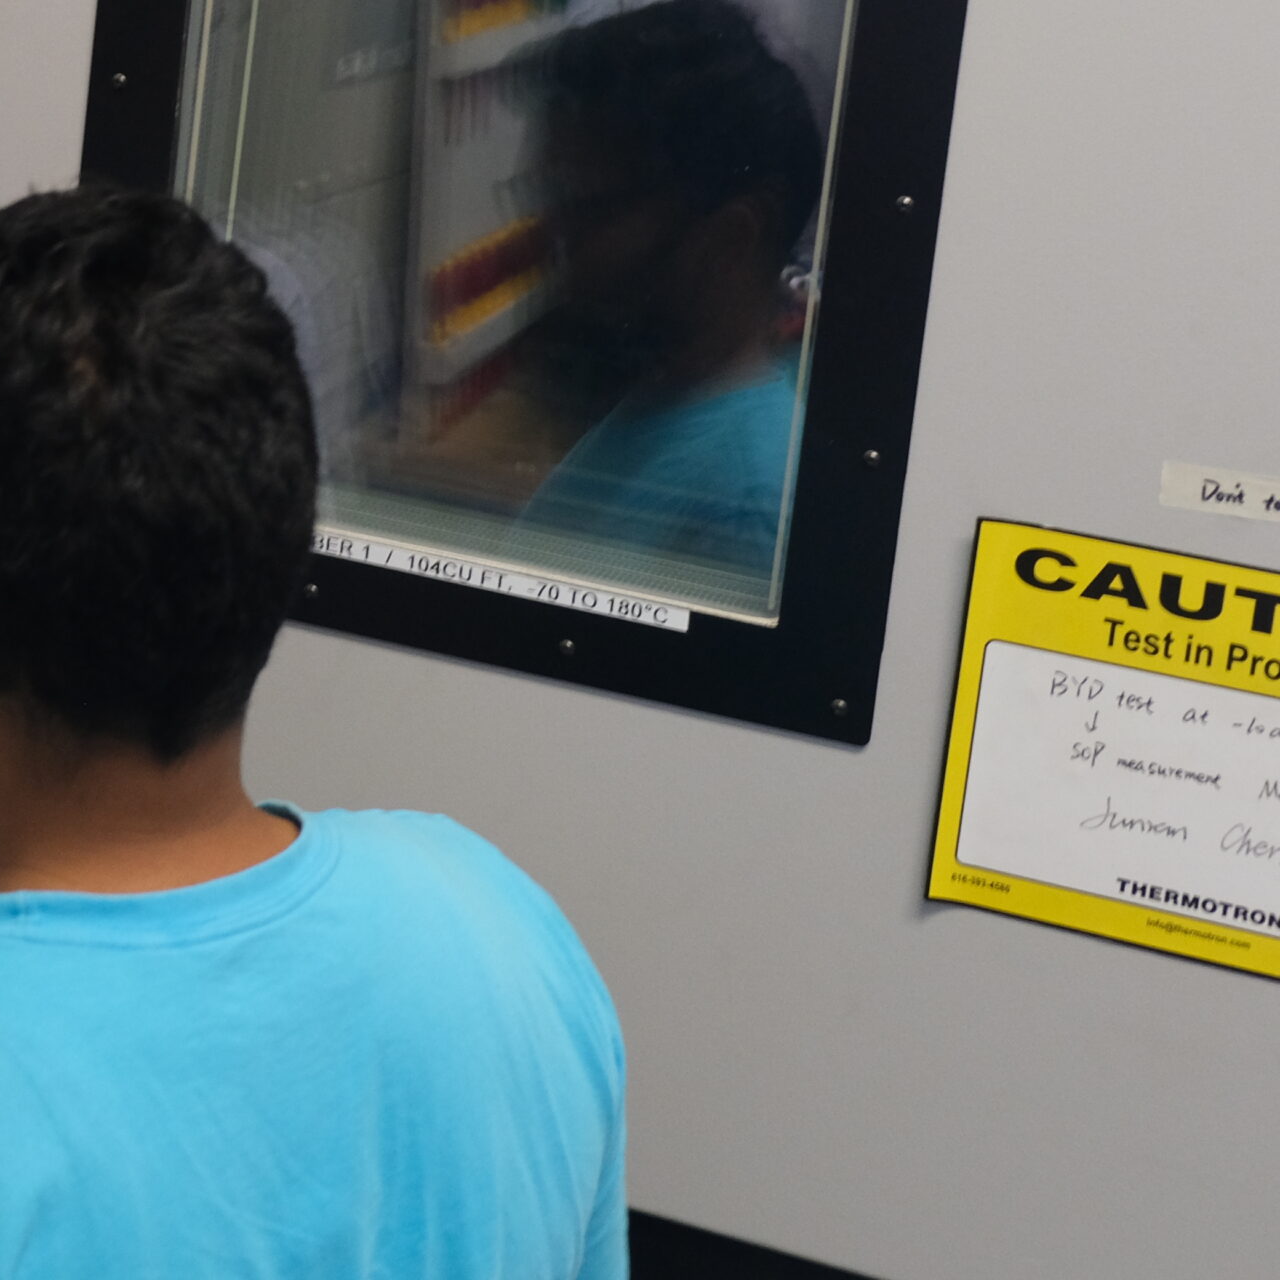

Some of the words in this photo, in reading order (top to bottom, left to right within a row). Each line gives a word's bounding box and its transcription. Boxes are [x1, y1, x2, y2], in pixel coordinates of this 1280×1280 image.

[362, 544, 370, 561] 1
[570, 587, 598, 609] TO
[608, 596, 669, 625] 180°C
[1014, 548, 1280, 635] CAUT
[1104, 617, 1174, 660] Test
[1184, 634, 1214, 668] in
[1226, 643, 1280, 681] Pro
[1050, 670, 1105, 701] BYD
[1116, 690, 1155, 714] test
[1117, 877, 1280, 930] THERMOTRON
